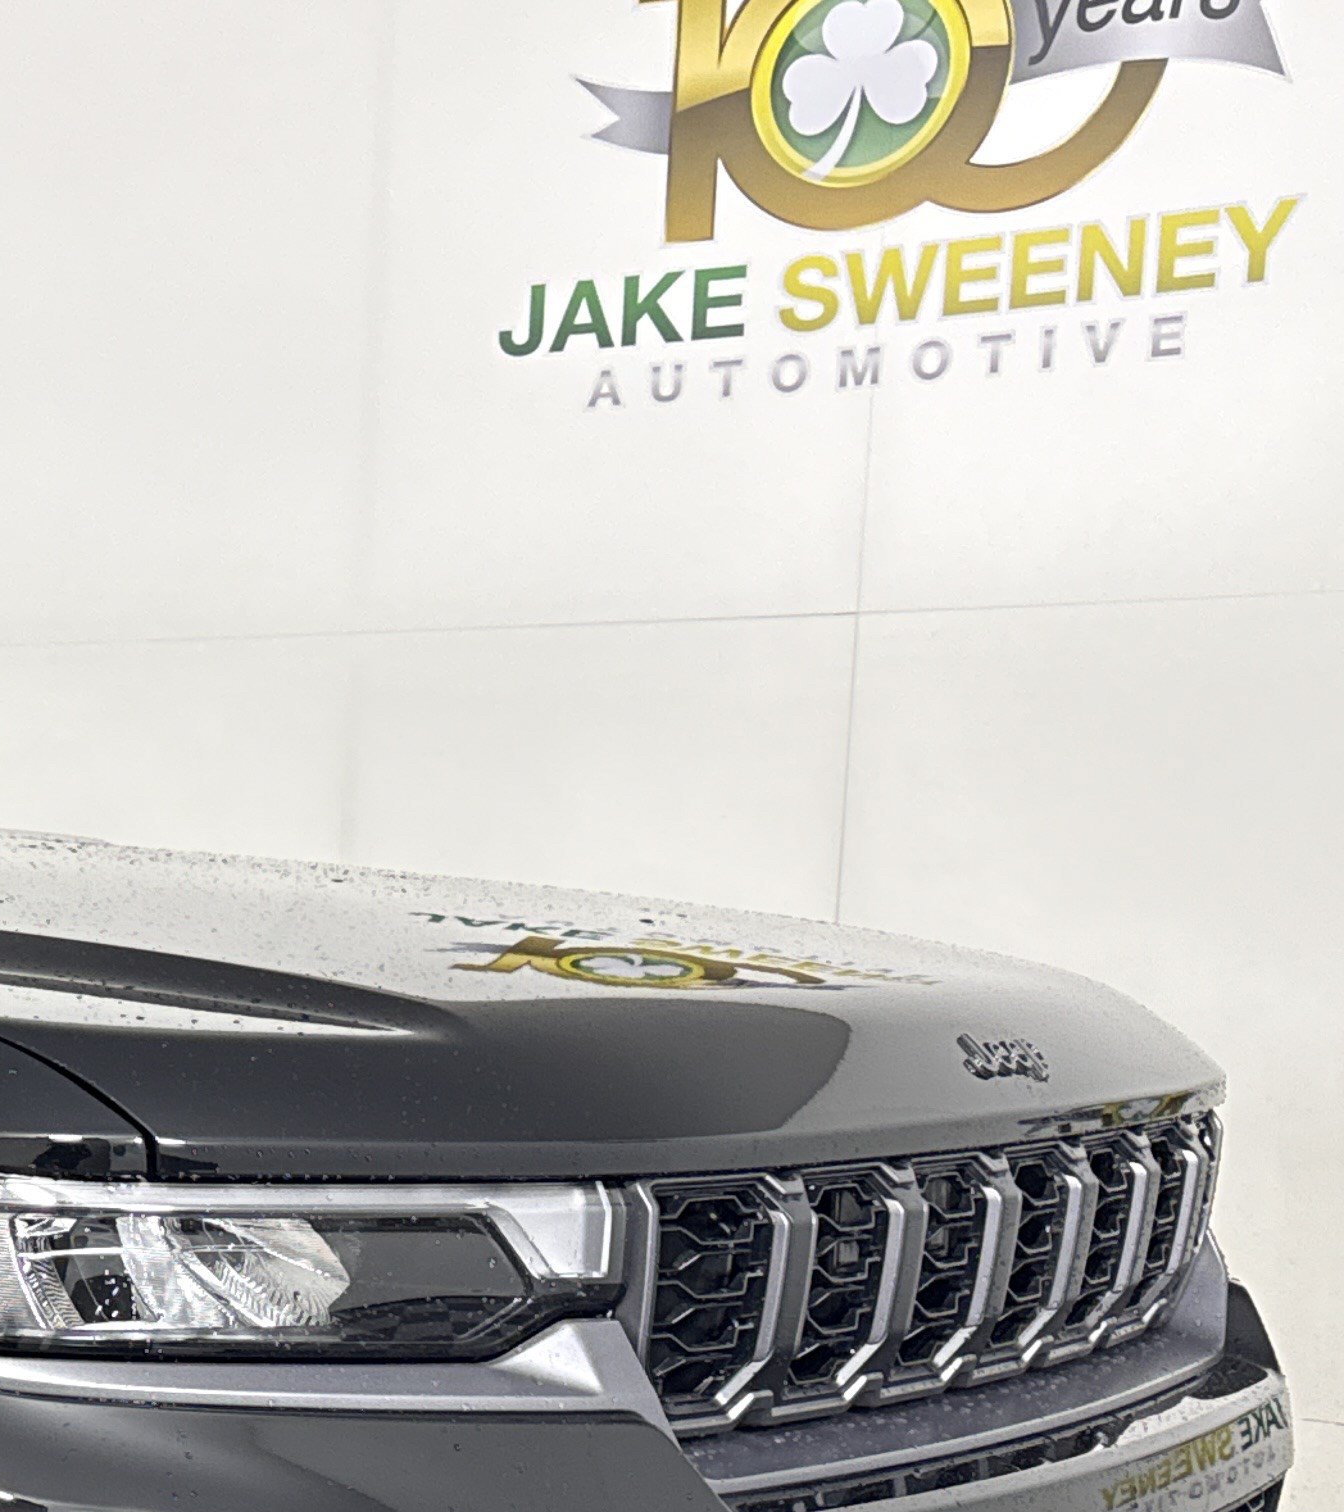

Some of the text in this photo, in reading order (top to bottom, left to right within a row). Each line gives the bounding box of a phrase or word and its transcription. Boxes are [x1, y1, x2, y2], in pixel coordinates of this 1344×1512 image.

[498, 198, 1300, 358] JAKE SWEENEY
[587, 313, 1186, 408] AUTOMOTIVE
